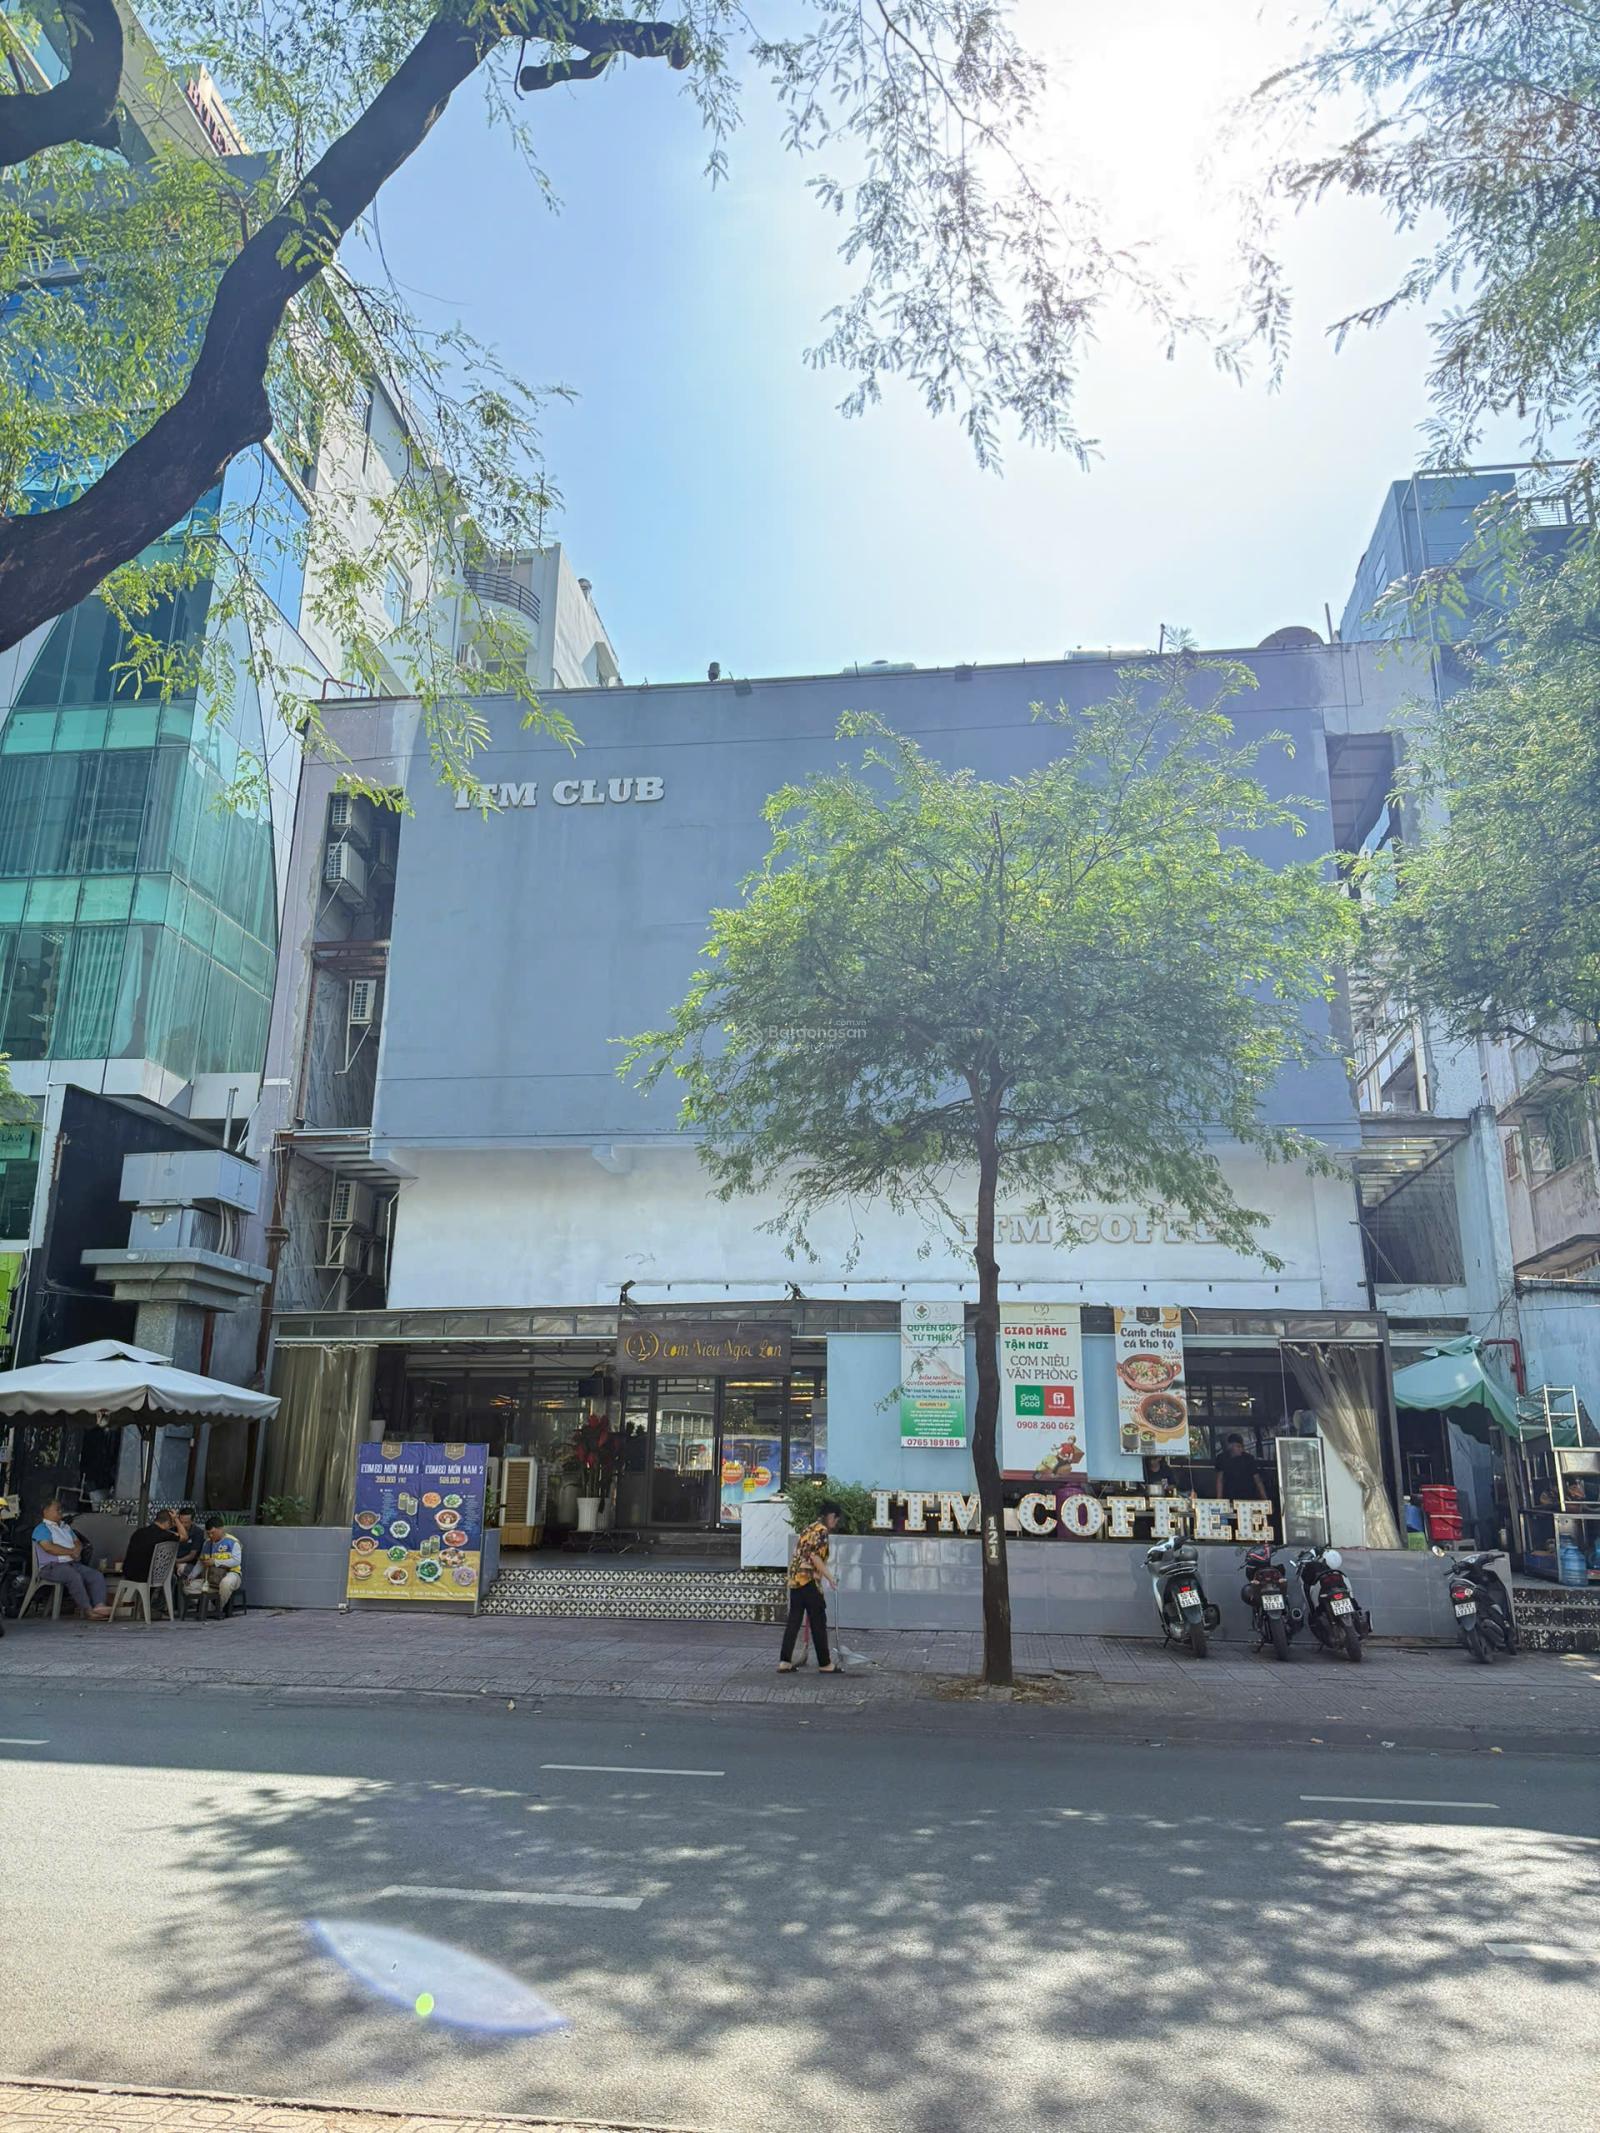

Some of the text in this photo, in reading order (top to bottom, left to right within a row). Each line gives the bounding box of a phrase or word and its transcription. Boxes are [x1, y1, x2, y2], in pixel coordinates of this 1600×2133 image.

[552, 776, 664, 805] CLUB
[1072, 1214, 1225, 1244] COFFE
[1004, 1324, 1067, 1336] GIAO HÀNG
[1120, 1327, 1176, 1338] Canh chua
[1123, 1338, 1137, 1349] cá
[1140, 1338, 1159, 1349] kho
[1010, 1353, 1070, 1367] CƠM NIÊU
[1006, 1367, 1078, 1381] VĂN PHÒNG
[1016, 1421, 1076, 1431] 0908 260 062
[871, 1490, 1274, 1542] ITM COFFEE
[987, 1515, 999, 1560] 121
